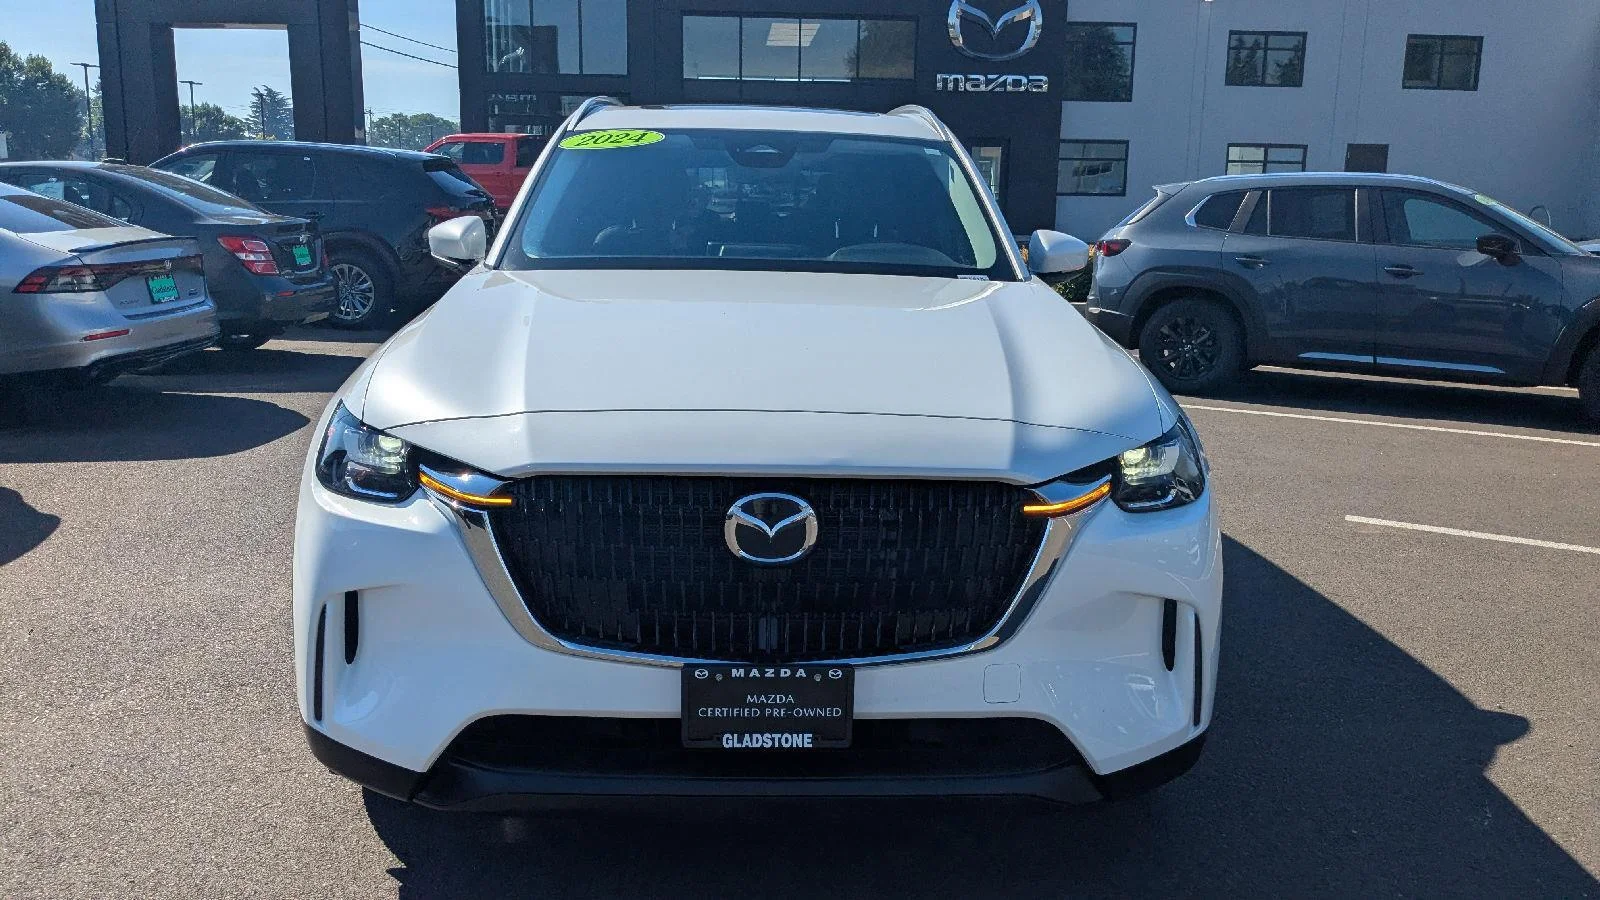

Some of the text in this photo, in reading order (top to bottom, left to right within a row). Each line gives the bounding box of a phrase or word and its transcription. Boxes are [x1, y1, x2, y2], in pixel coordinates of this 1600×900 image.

[574, 132, 649, 147] 2024
[731, 668, 807, 678] MAZDA
[746, 694, 795, 704] MAZDA
[698, 707, 842, 717] CERTIFIED PRE-OWNED
[722, 733, 813, 748] GLADSTONE
